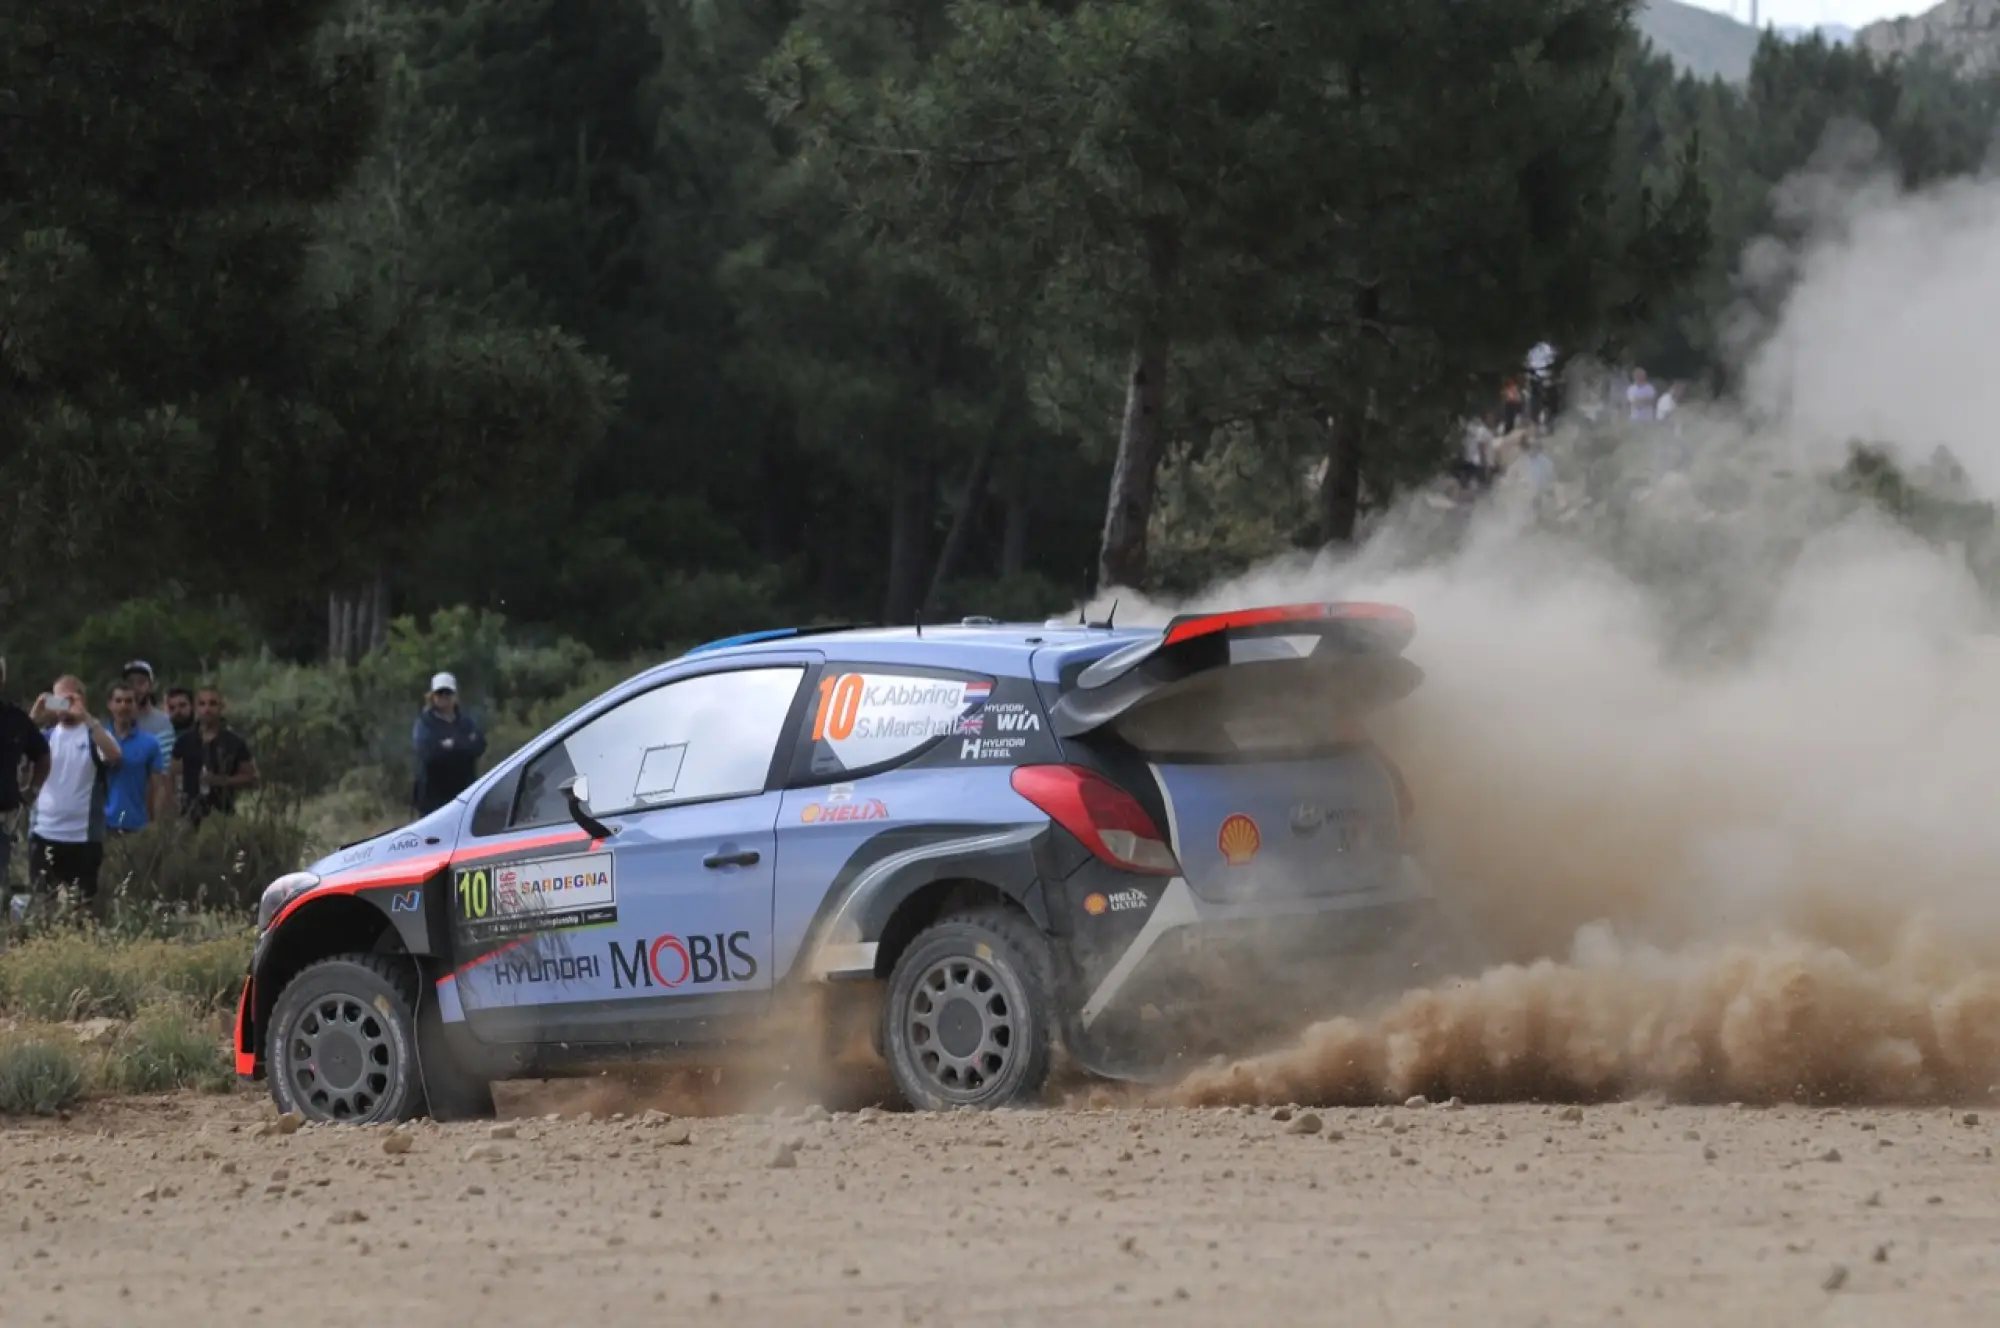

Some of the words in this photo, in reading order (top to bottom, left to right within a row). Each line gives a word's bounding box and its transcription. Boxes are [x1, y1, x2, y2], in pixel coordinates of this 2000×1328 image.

[812, 673, 864, 741] 10
[862, 685, 960, 709] K.Abbring
[984, 703, 1025, 713] HYUNDAI
[980, 748, 1011, 759] STEEL
[983, 737, 1026, 748] HYUNDAI
[819, 798, 889, 823] HELIX
[387, 839, 419, 853] AMG
[458, 871, 488, 919] 10
[521, 871, 609, 895] SARDEGNA
[1109, 888, 1149, 902] HELIX
[1110, 899, 1148, 911] ULTRA
[494, 954, 600, 985] HYUNDAI
[608, 930, 758, 990] MOBIS
